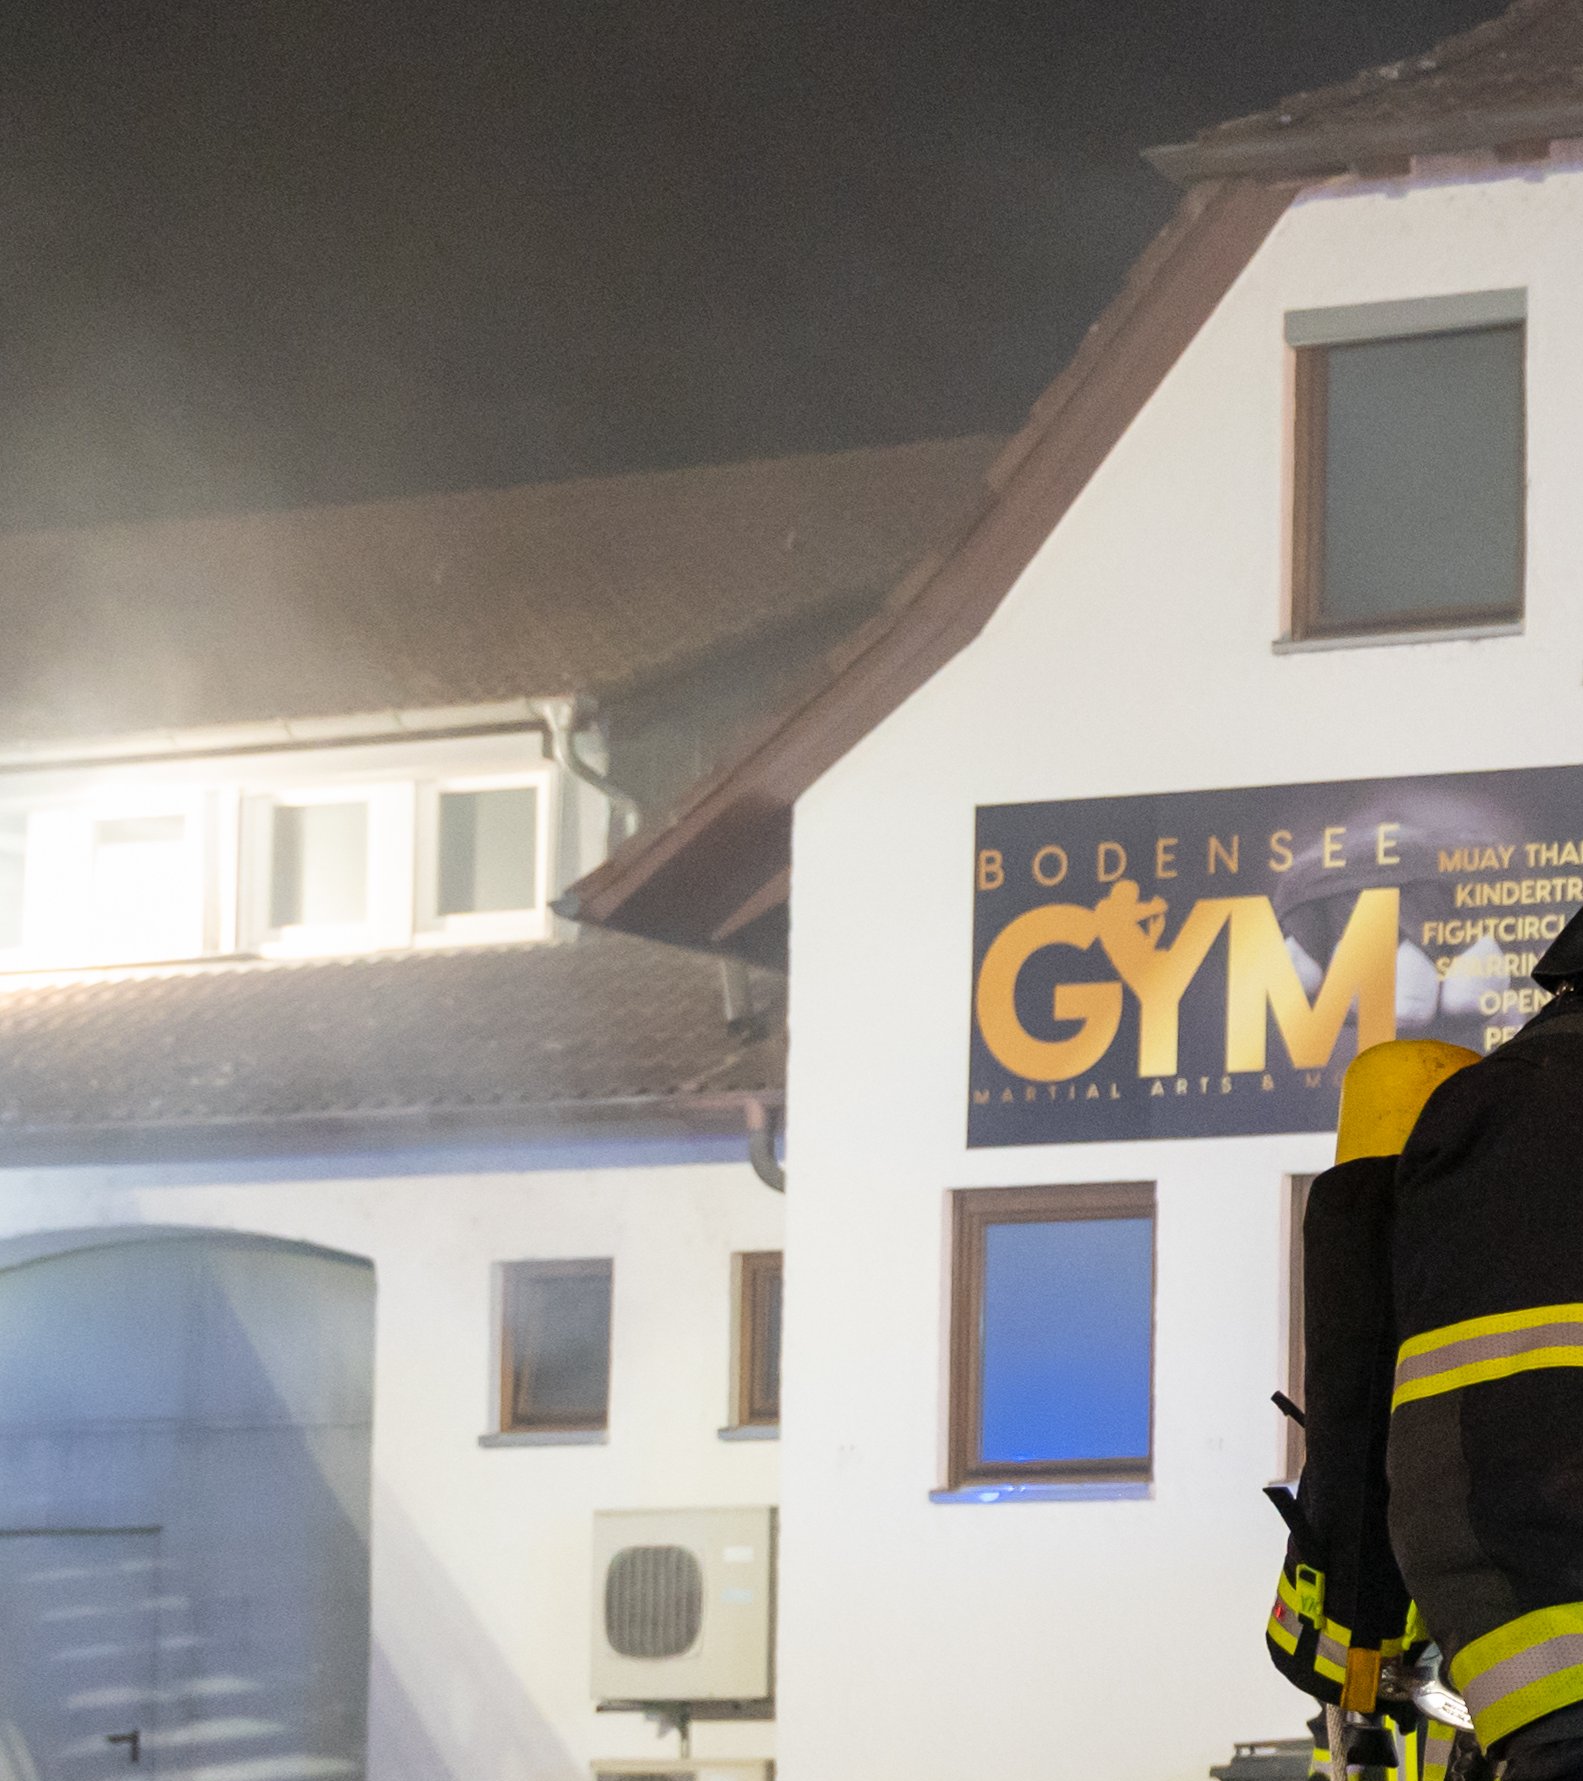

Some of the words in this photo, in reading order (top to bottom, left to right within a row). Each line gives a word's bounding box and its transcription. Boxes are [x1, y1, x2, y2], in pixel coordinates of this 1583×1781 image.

[976, 822, 1401, 891] BODENSEE
[1437, 845, 1515, 873] MUAY
[974, 879, 1401, 1083] GYM
[1479, 988, 1555, 1017] OPEN
[972, 1082, 1122, 1105] MARTIAL
[1150, 1075, 1234, 1097] ARTS
